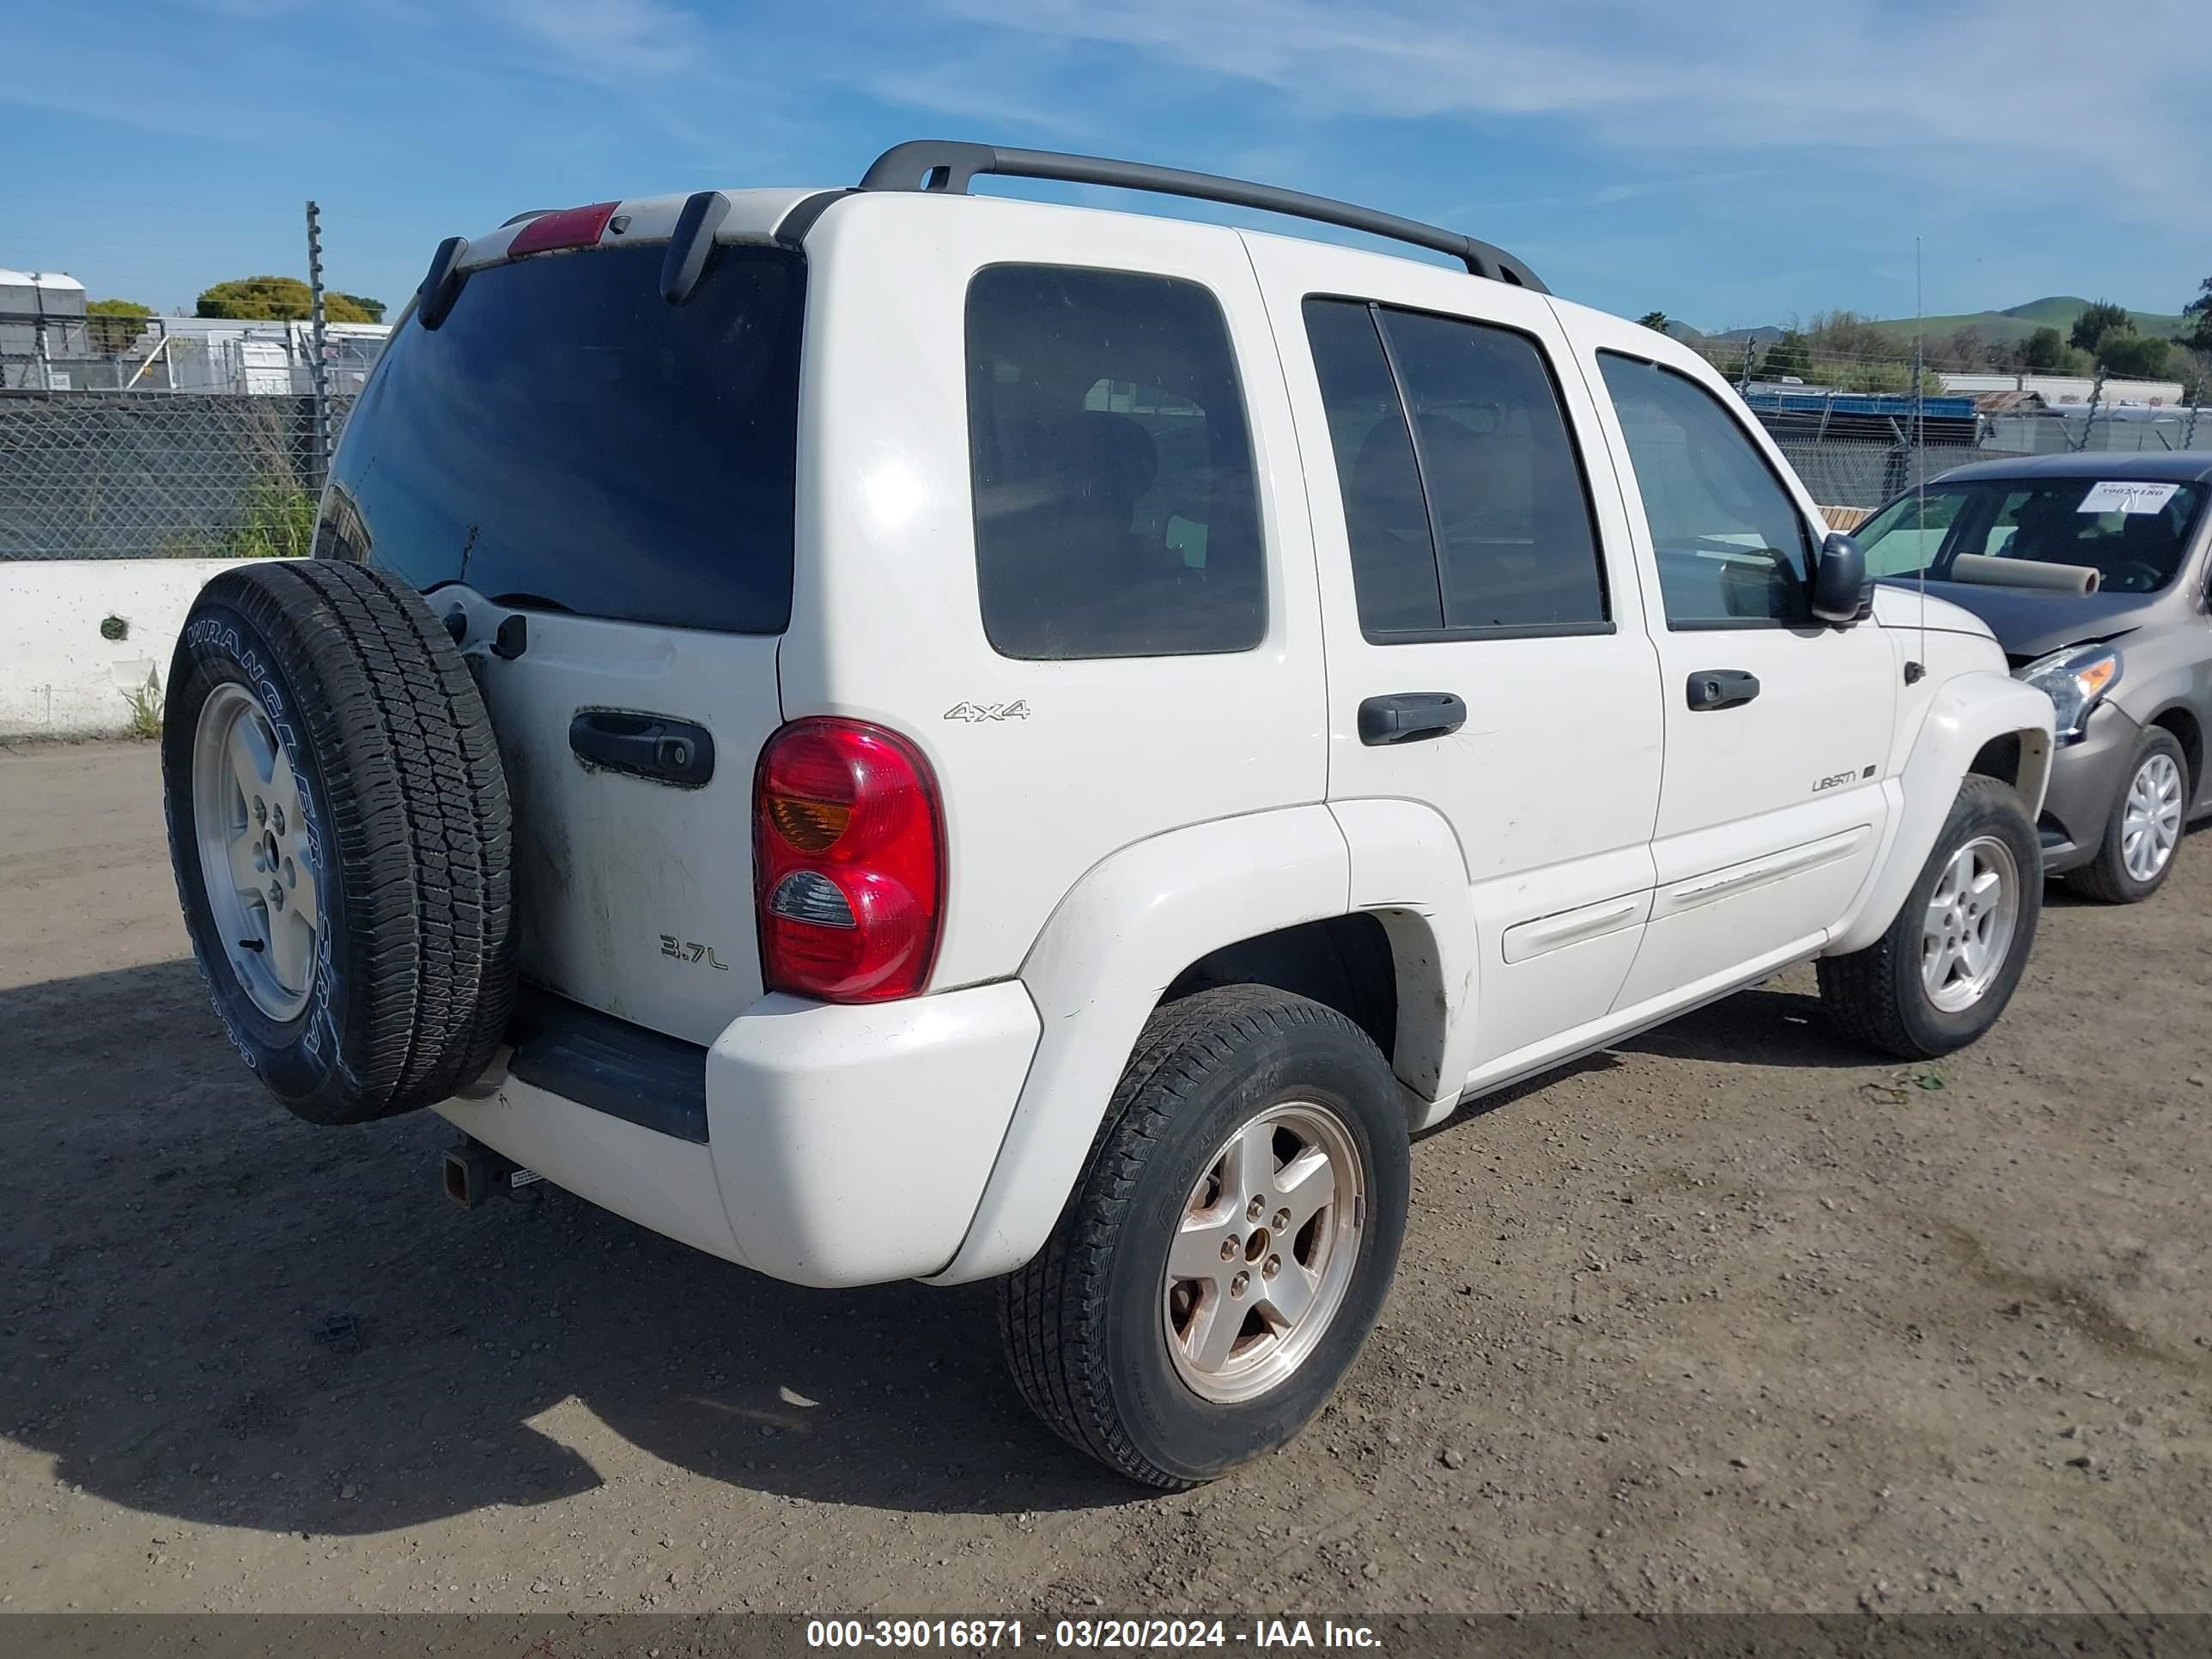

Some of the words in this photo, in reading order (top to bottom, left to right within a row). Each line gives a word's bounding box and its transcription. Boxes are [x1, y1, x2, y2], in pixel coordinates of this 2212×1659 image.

[186, 619, 325, 871] WRANGLER
[1811, 770, 1862, 793] LIBERTY
[659, 933, 729, 971] 3.7L
